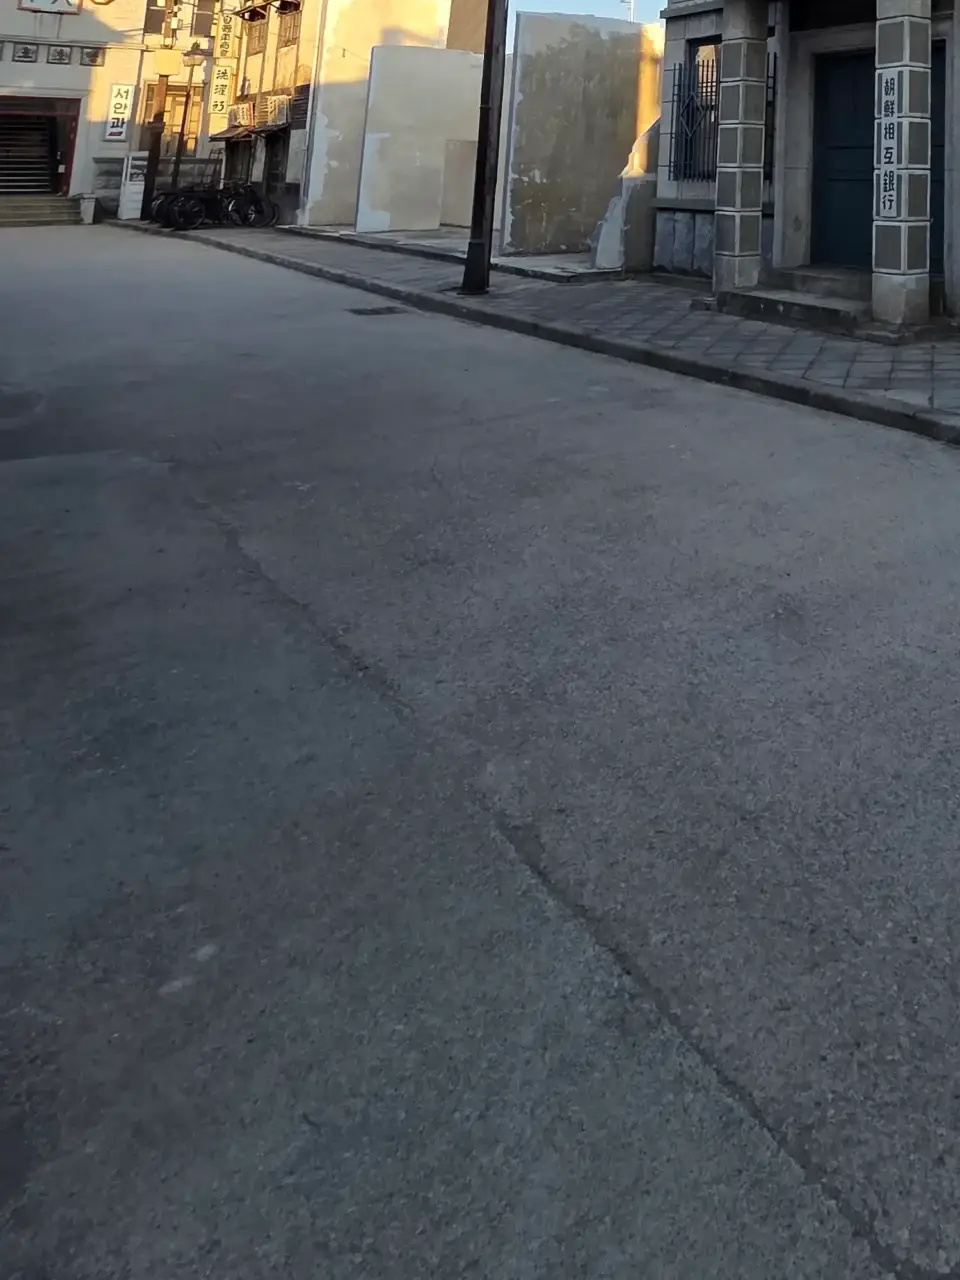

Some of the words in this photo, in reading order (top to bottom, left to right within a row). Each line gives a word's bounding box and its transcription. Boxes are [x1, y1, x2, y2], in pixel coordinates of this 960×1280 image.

[109, 87, 130, 129] 서안과
[882, 77, 896, 211] 朝鮮相互銀行
